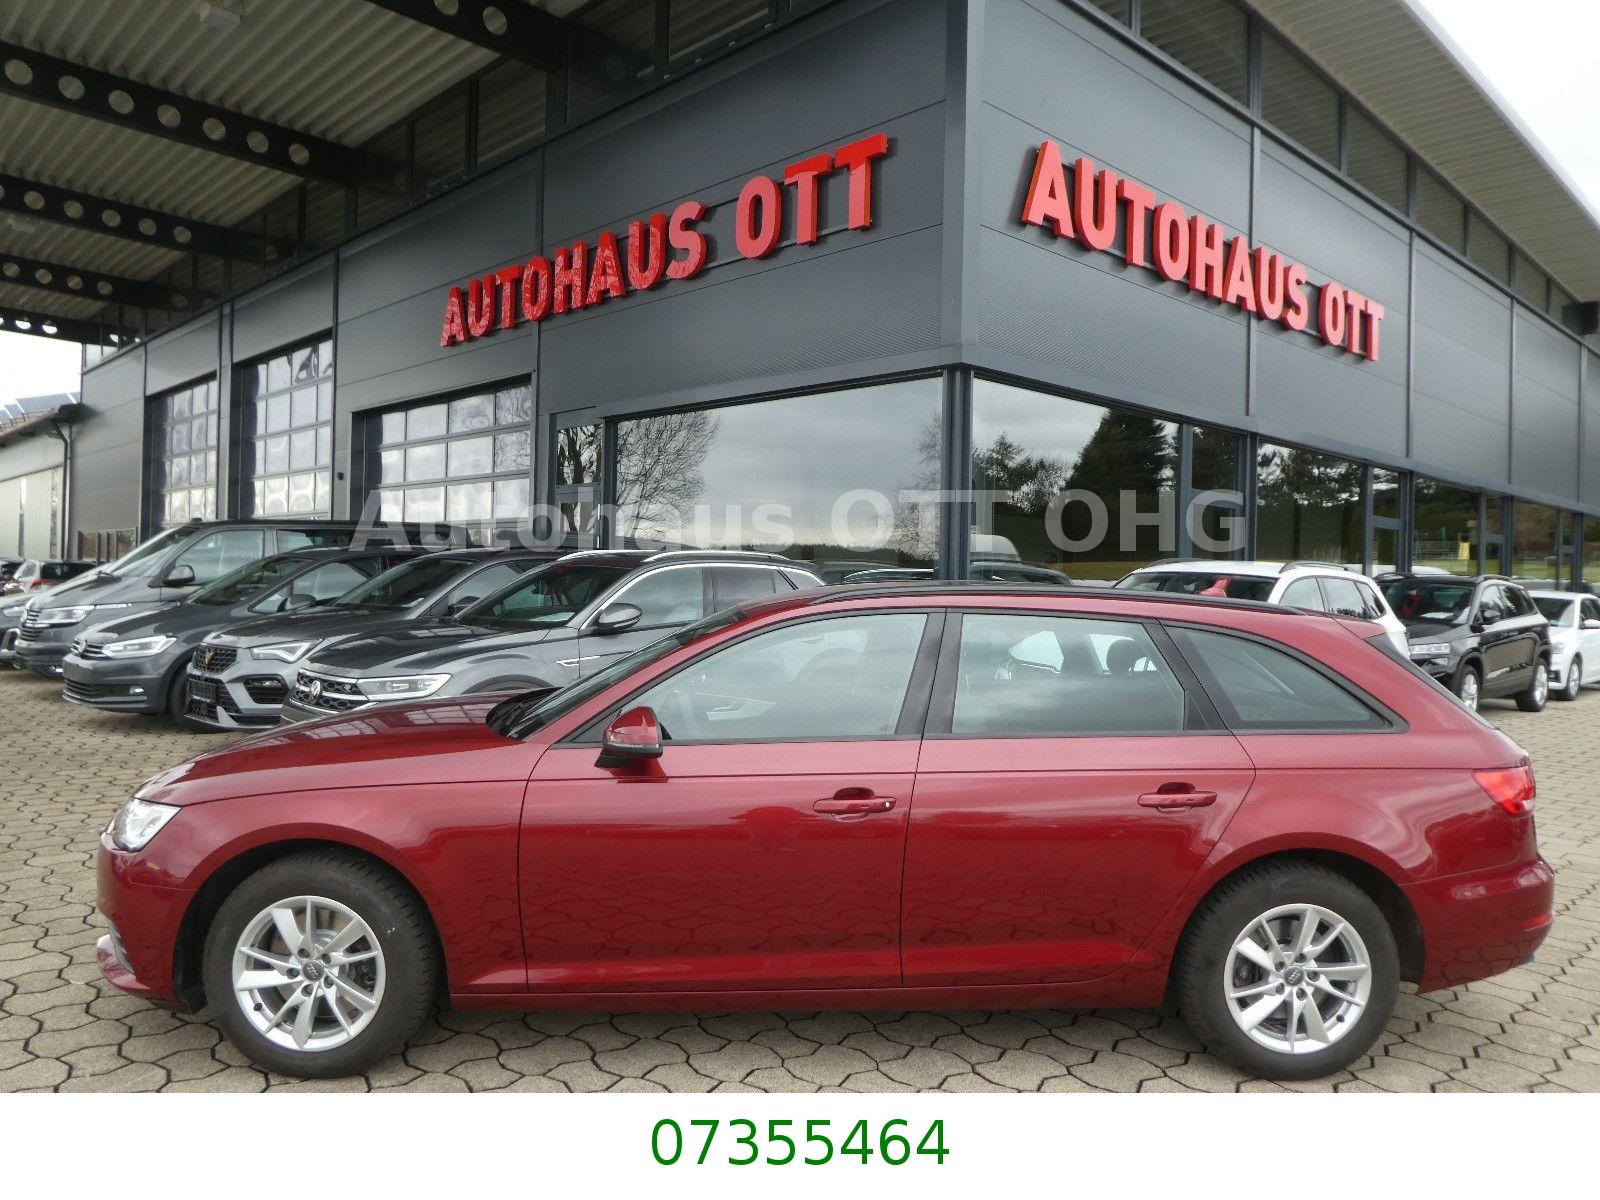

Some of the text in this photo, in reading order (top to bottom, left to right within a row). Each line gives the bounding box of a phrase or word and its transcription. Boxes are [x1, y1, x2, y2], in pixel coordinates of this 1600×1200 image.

[440, 133, 889, 347] AUTOHAUS OTT
[1022, 140, 1384, 361] AUTOHAUS OTT
